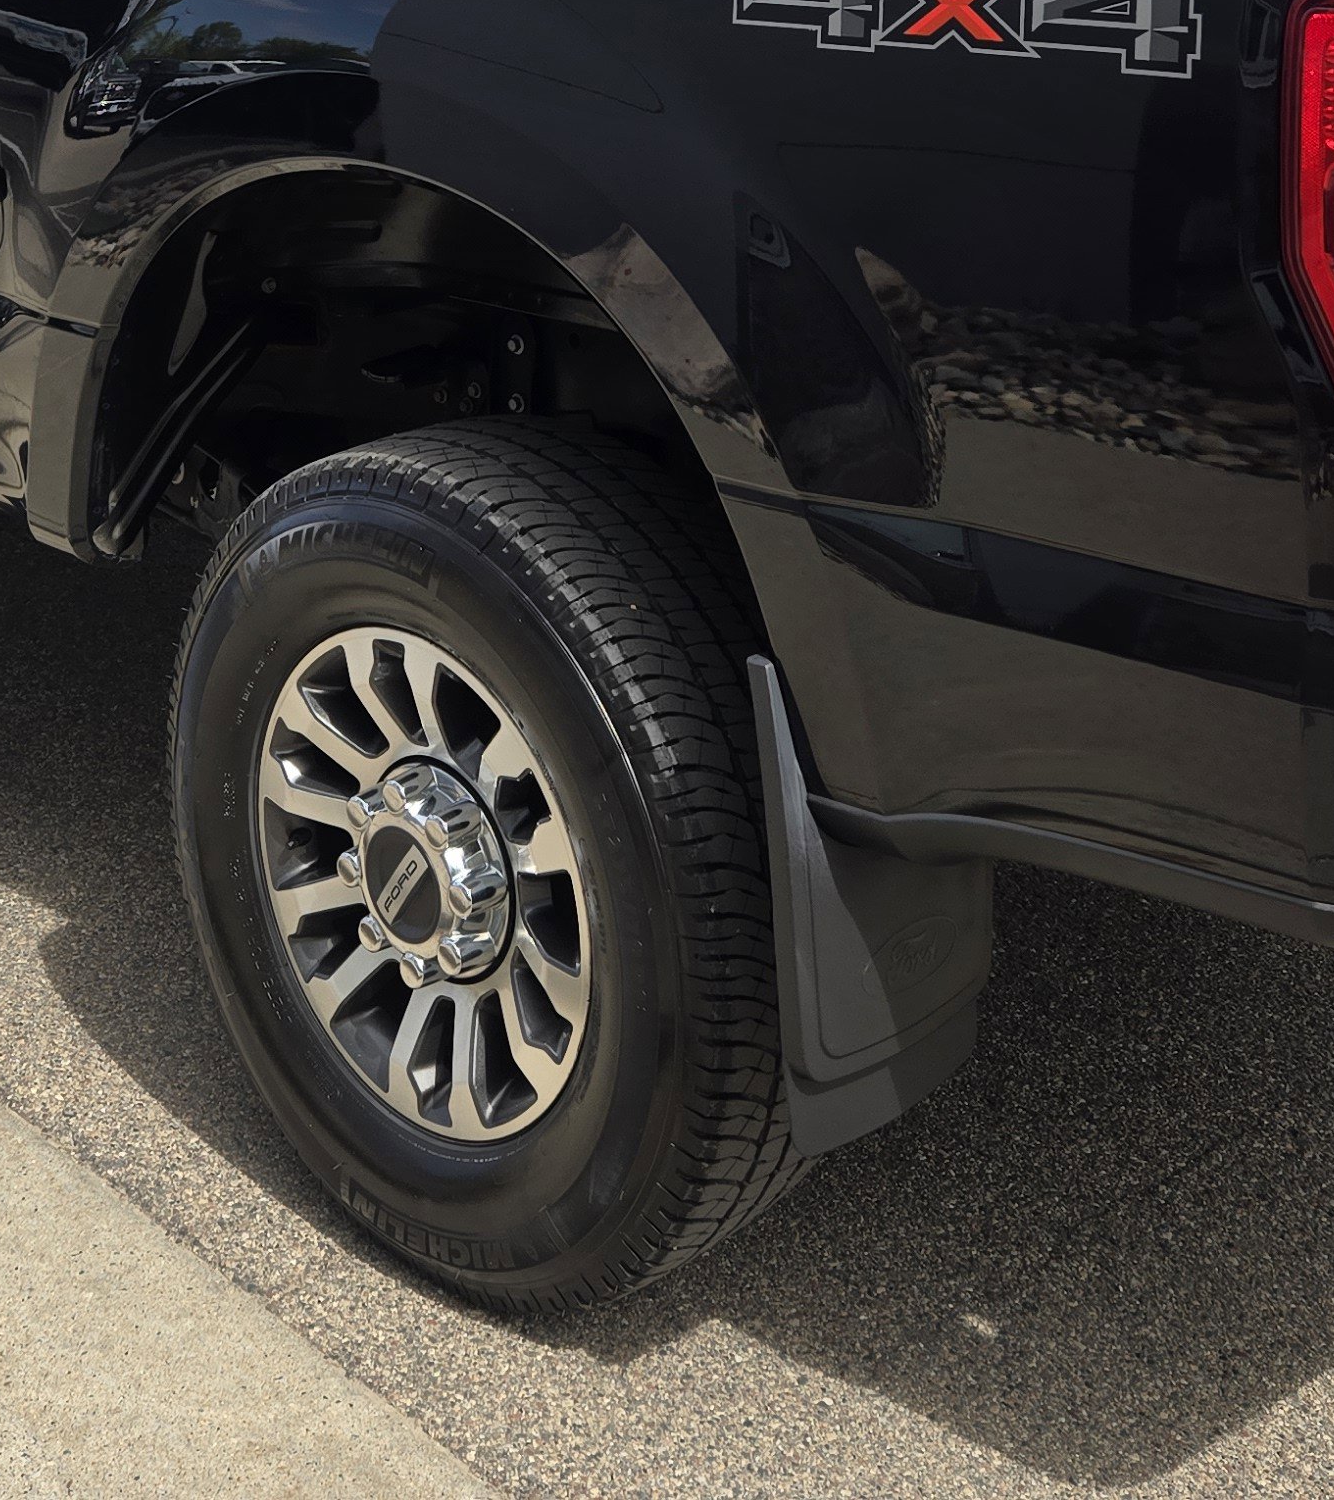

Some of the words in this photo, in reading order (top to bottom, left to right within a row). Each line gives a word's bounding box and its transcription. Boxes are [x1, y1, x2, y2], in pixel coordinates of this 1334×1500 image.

[277, 521, 437, 587] MICHELIN
[384, 860, 418, 913] FORD
[889, 927, 939, 974] Ford
[349, 1184, 516, 1270] MICHELIN
